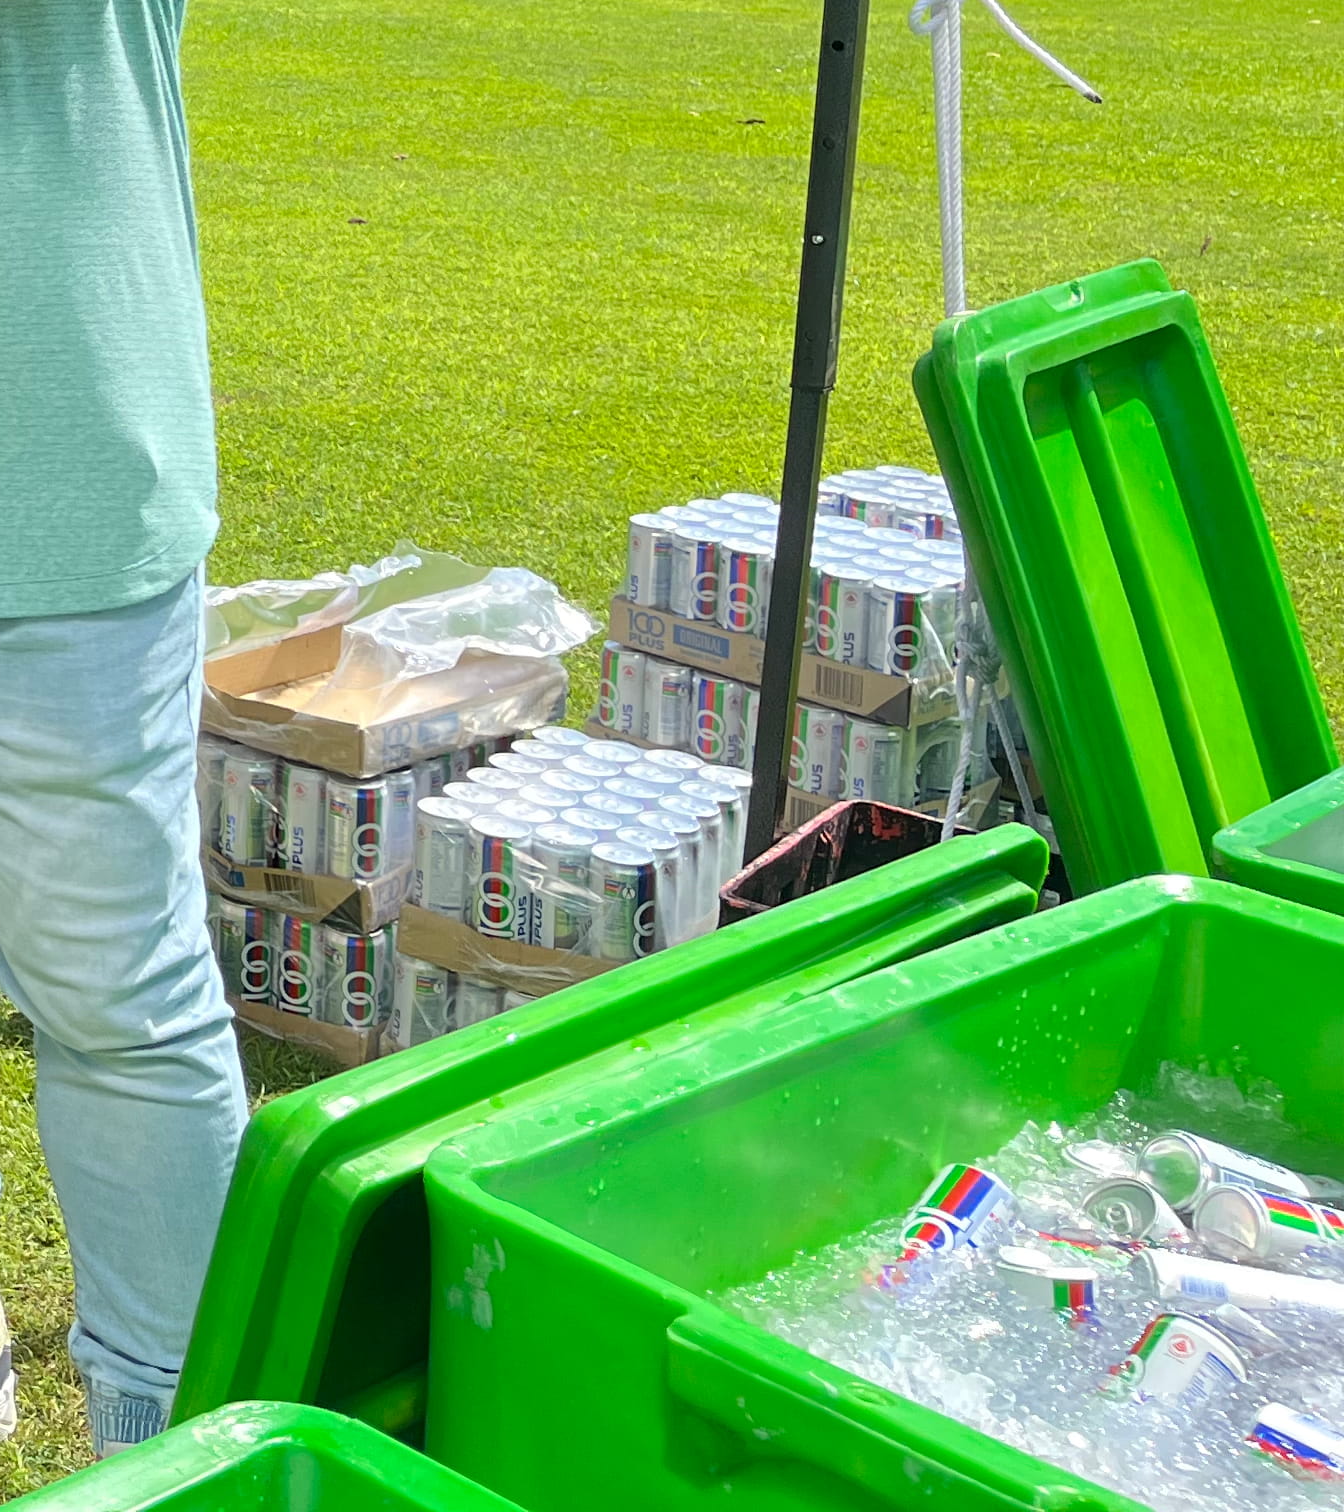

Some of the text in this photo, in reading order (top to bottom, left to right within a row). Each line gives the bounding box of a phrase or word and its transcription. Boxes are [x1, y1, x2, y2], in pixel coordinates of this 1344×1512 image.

[627, 607, 665, 639] 100
[629, 632, 665, 651] PLUS
[293, 826, 304, 865] PLUS
[518, 895, 528, 936] PLUS
